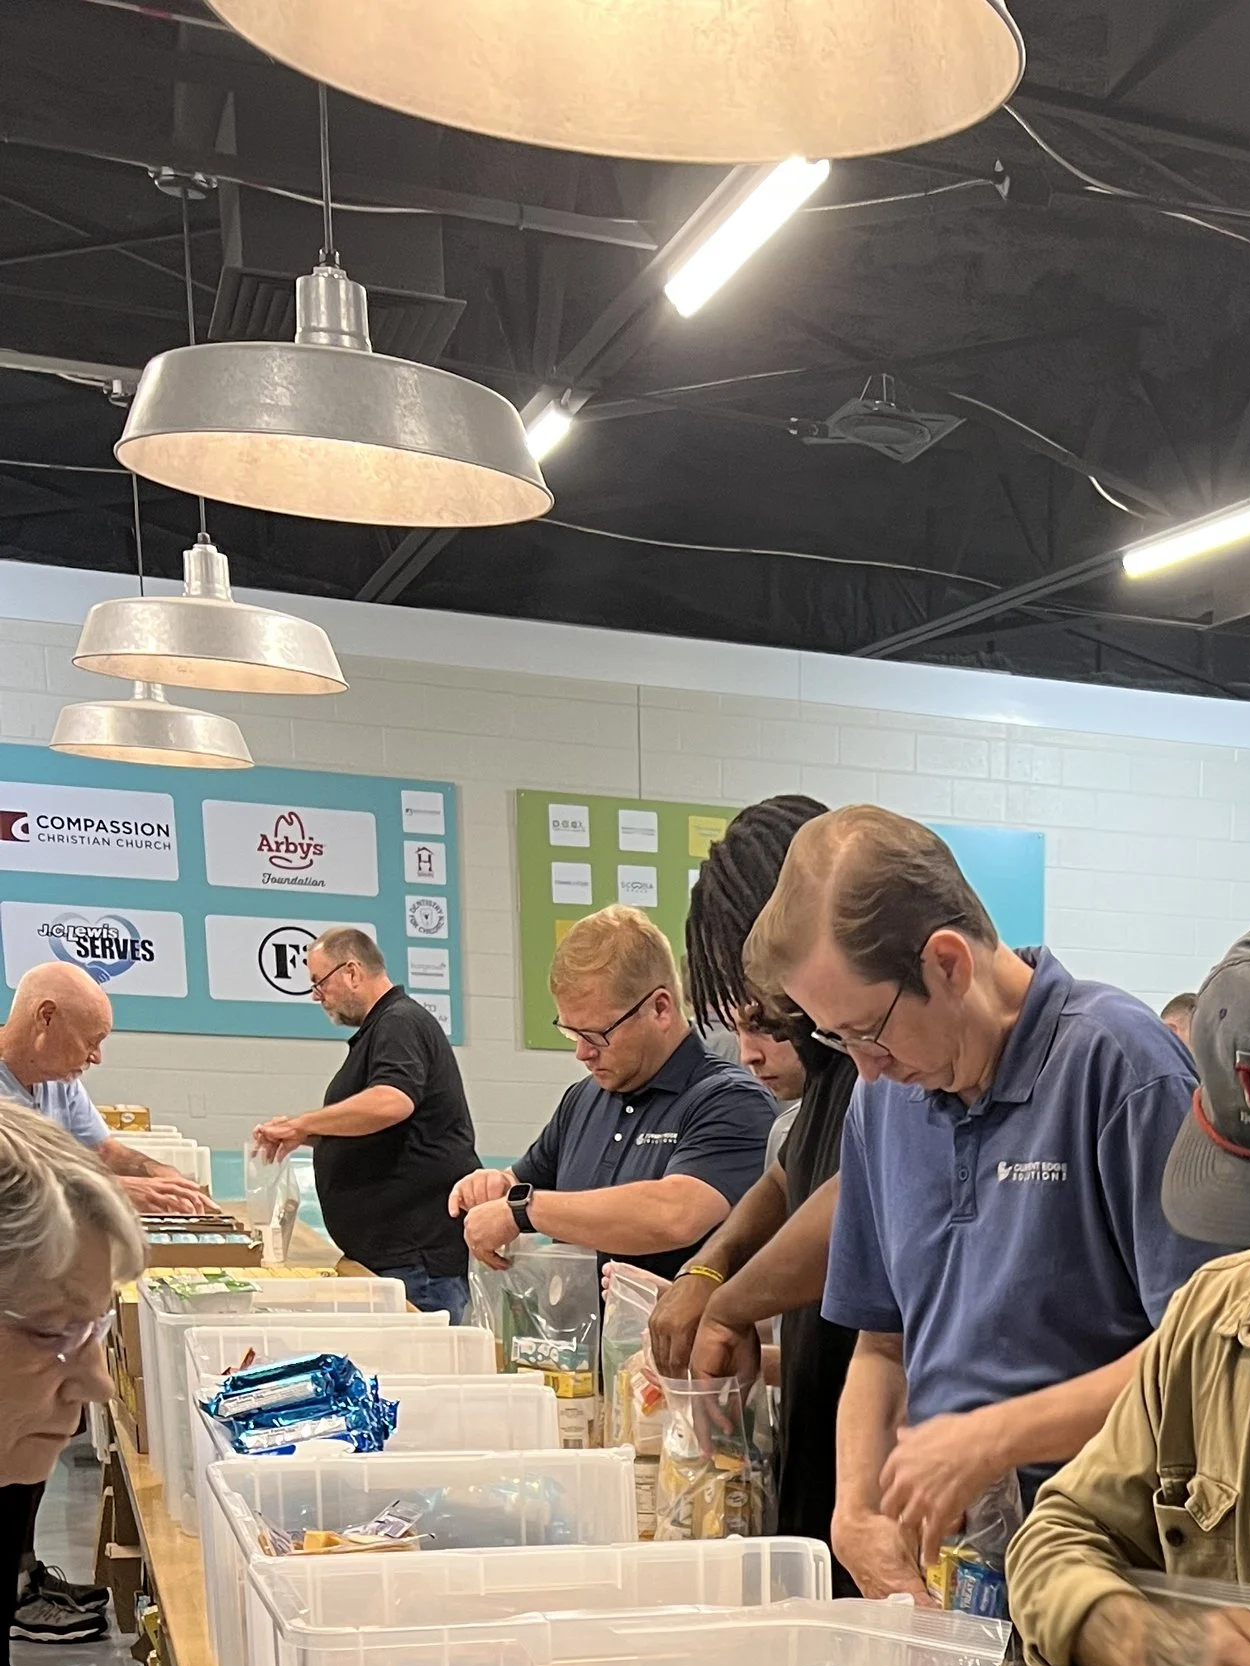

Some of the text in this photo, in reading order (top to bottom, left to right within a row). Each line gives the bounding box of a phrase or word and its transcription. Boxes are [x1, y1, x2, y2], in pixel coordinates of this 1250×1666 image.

[36, 815, 170, 837] COMPASSION
[37, 832, 171, 850] CHRISTIAN CHURCH
[257, 834, 324, 860] Arby's
[261, 872, 326, 887] Foundation
[76, 937, 155, 962] SERVES
